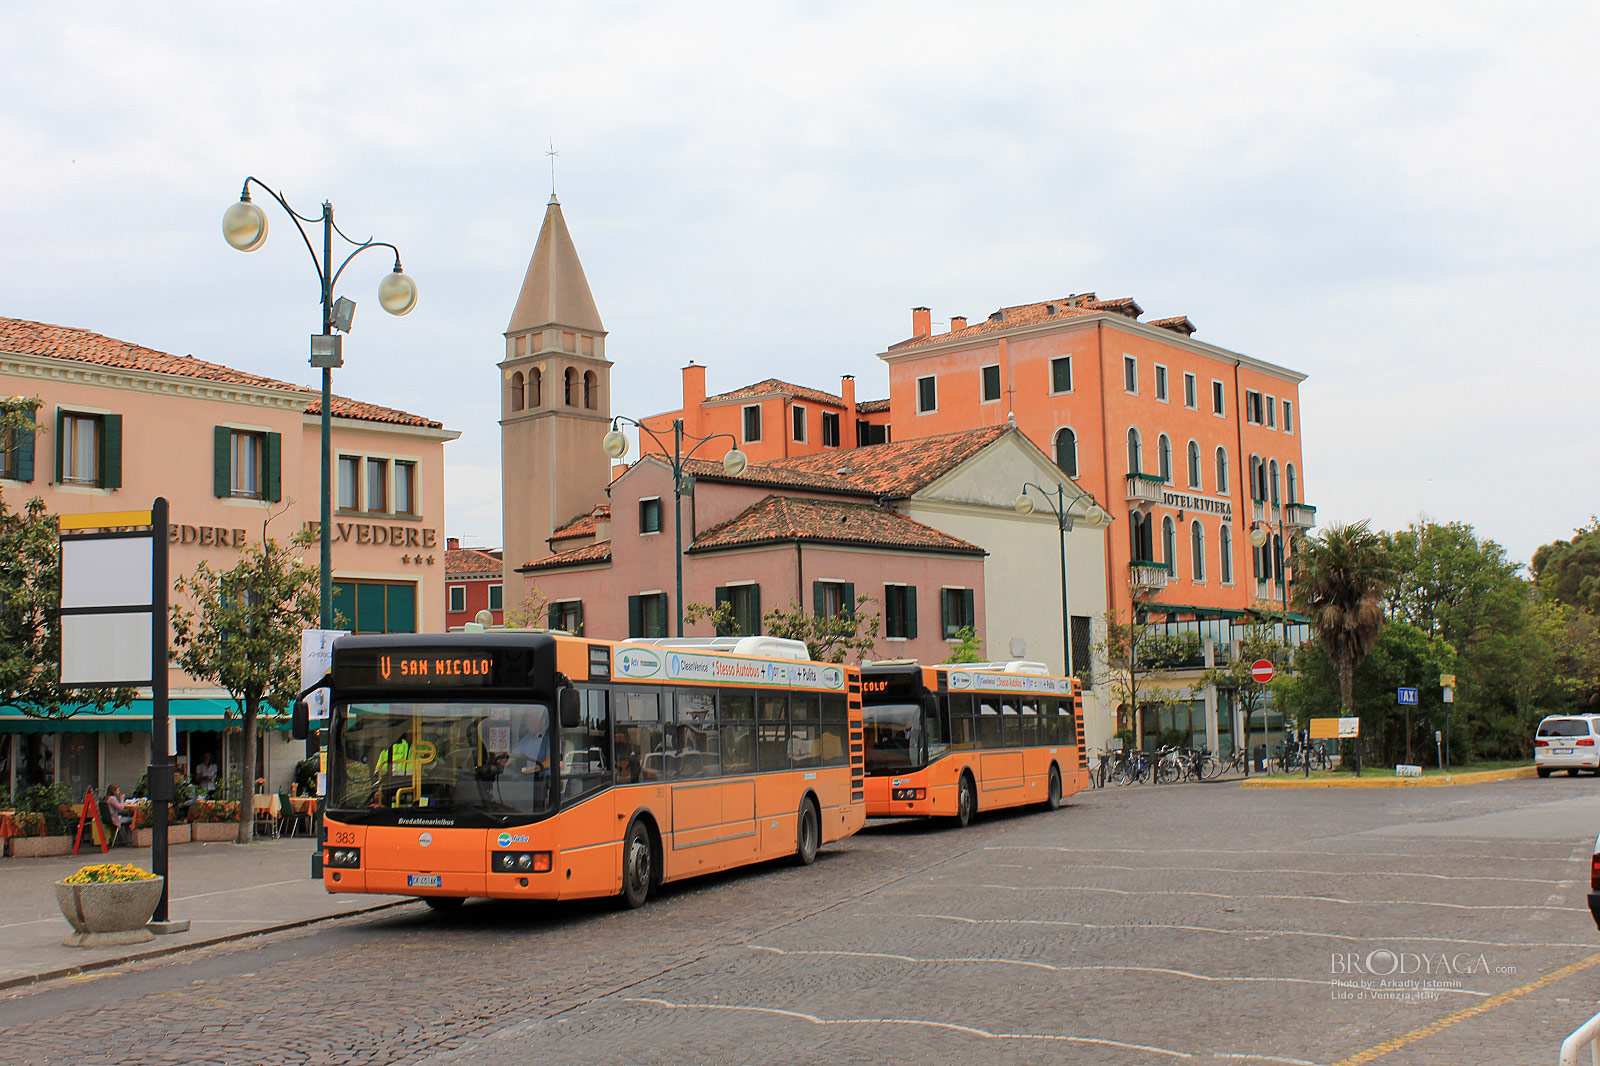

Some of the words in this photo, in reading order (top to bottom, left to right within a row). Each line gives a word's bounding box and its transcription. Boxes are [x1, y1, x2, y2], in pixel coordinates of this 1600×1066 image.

[1193, 497, 1231, 514] RIVIERA
[169, 523, 247, 549] EDERE
[400, 659, 428, 676] SAN
[435, 659, 494, 676] NICOLO'
[716, 660, 735, 676] Stesso
[736, 663, 760, 678] Autobus
[1399, 690, 1417, 702] TAXI
[335, 832, 355, 844] 383
